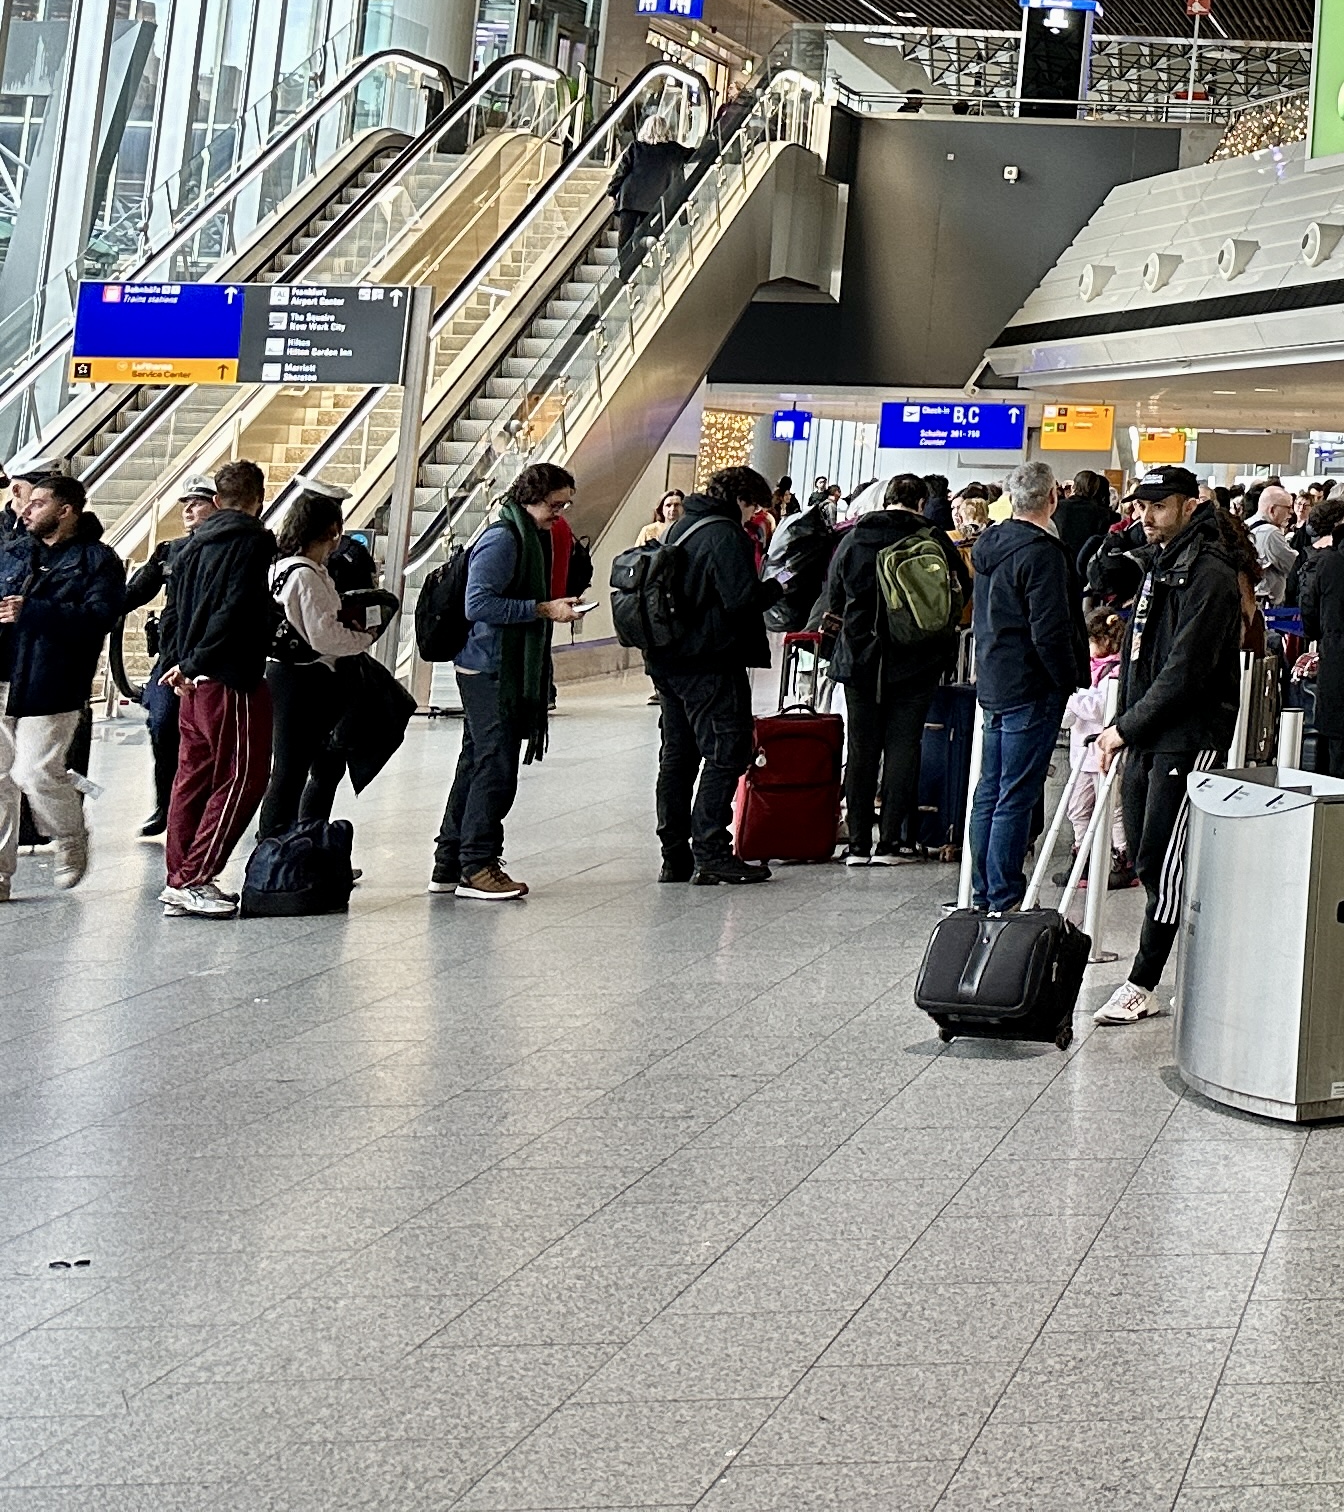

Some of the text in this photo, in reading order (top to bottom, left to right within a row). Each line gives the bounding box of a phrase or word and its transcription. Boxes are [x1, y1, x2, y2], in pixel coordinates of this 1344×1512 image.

[290, 312, 304, 321] The
[330, 322, 346, 333] City
[163, 371, 192, 379] Center
[953, 406, 980, 425] B,C
